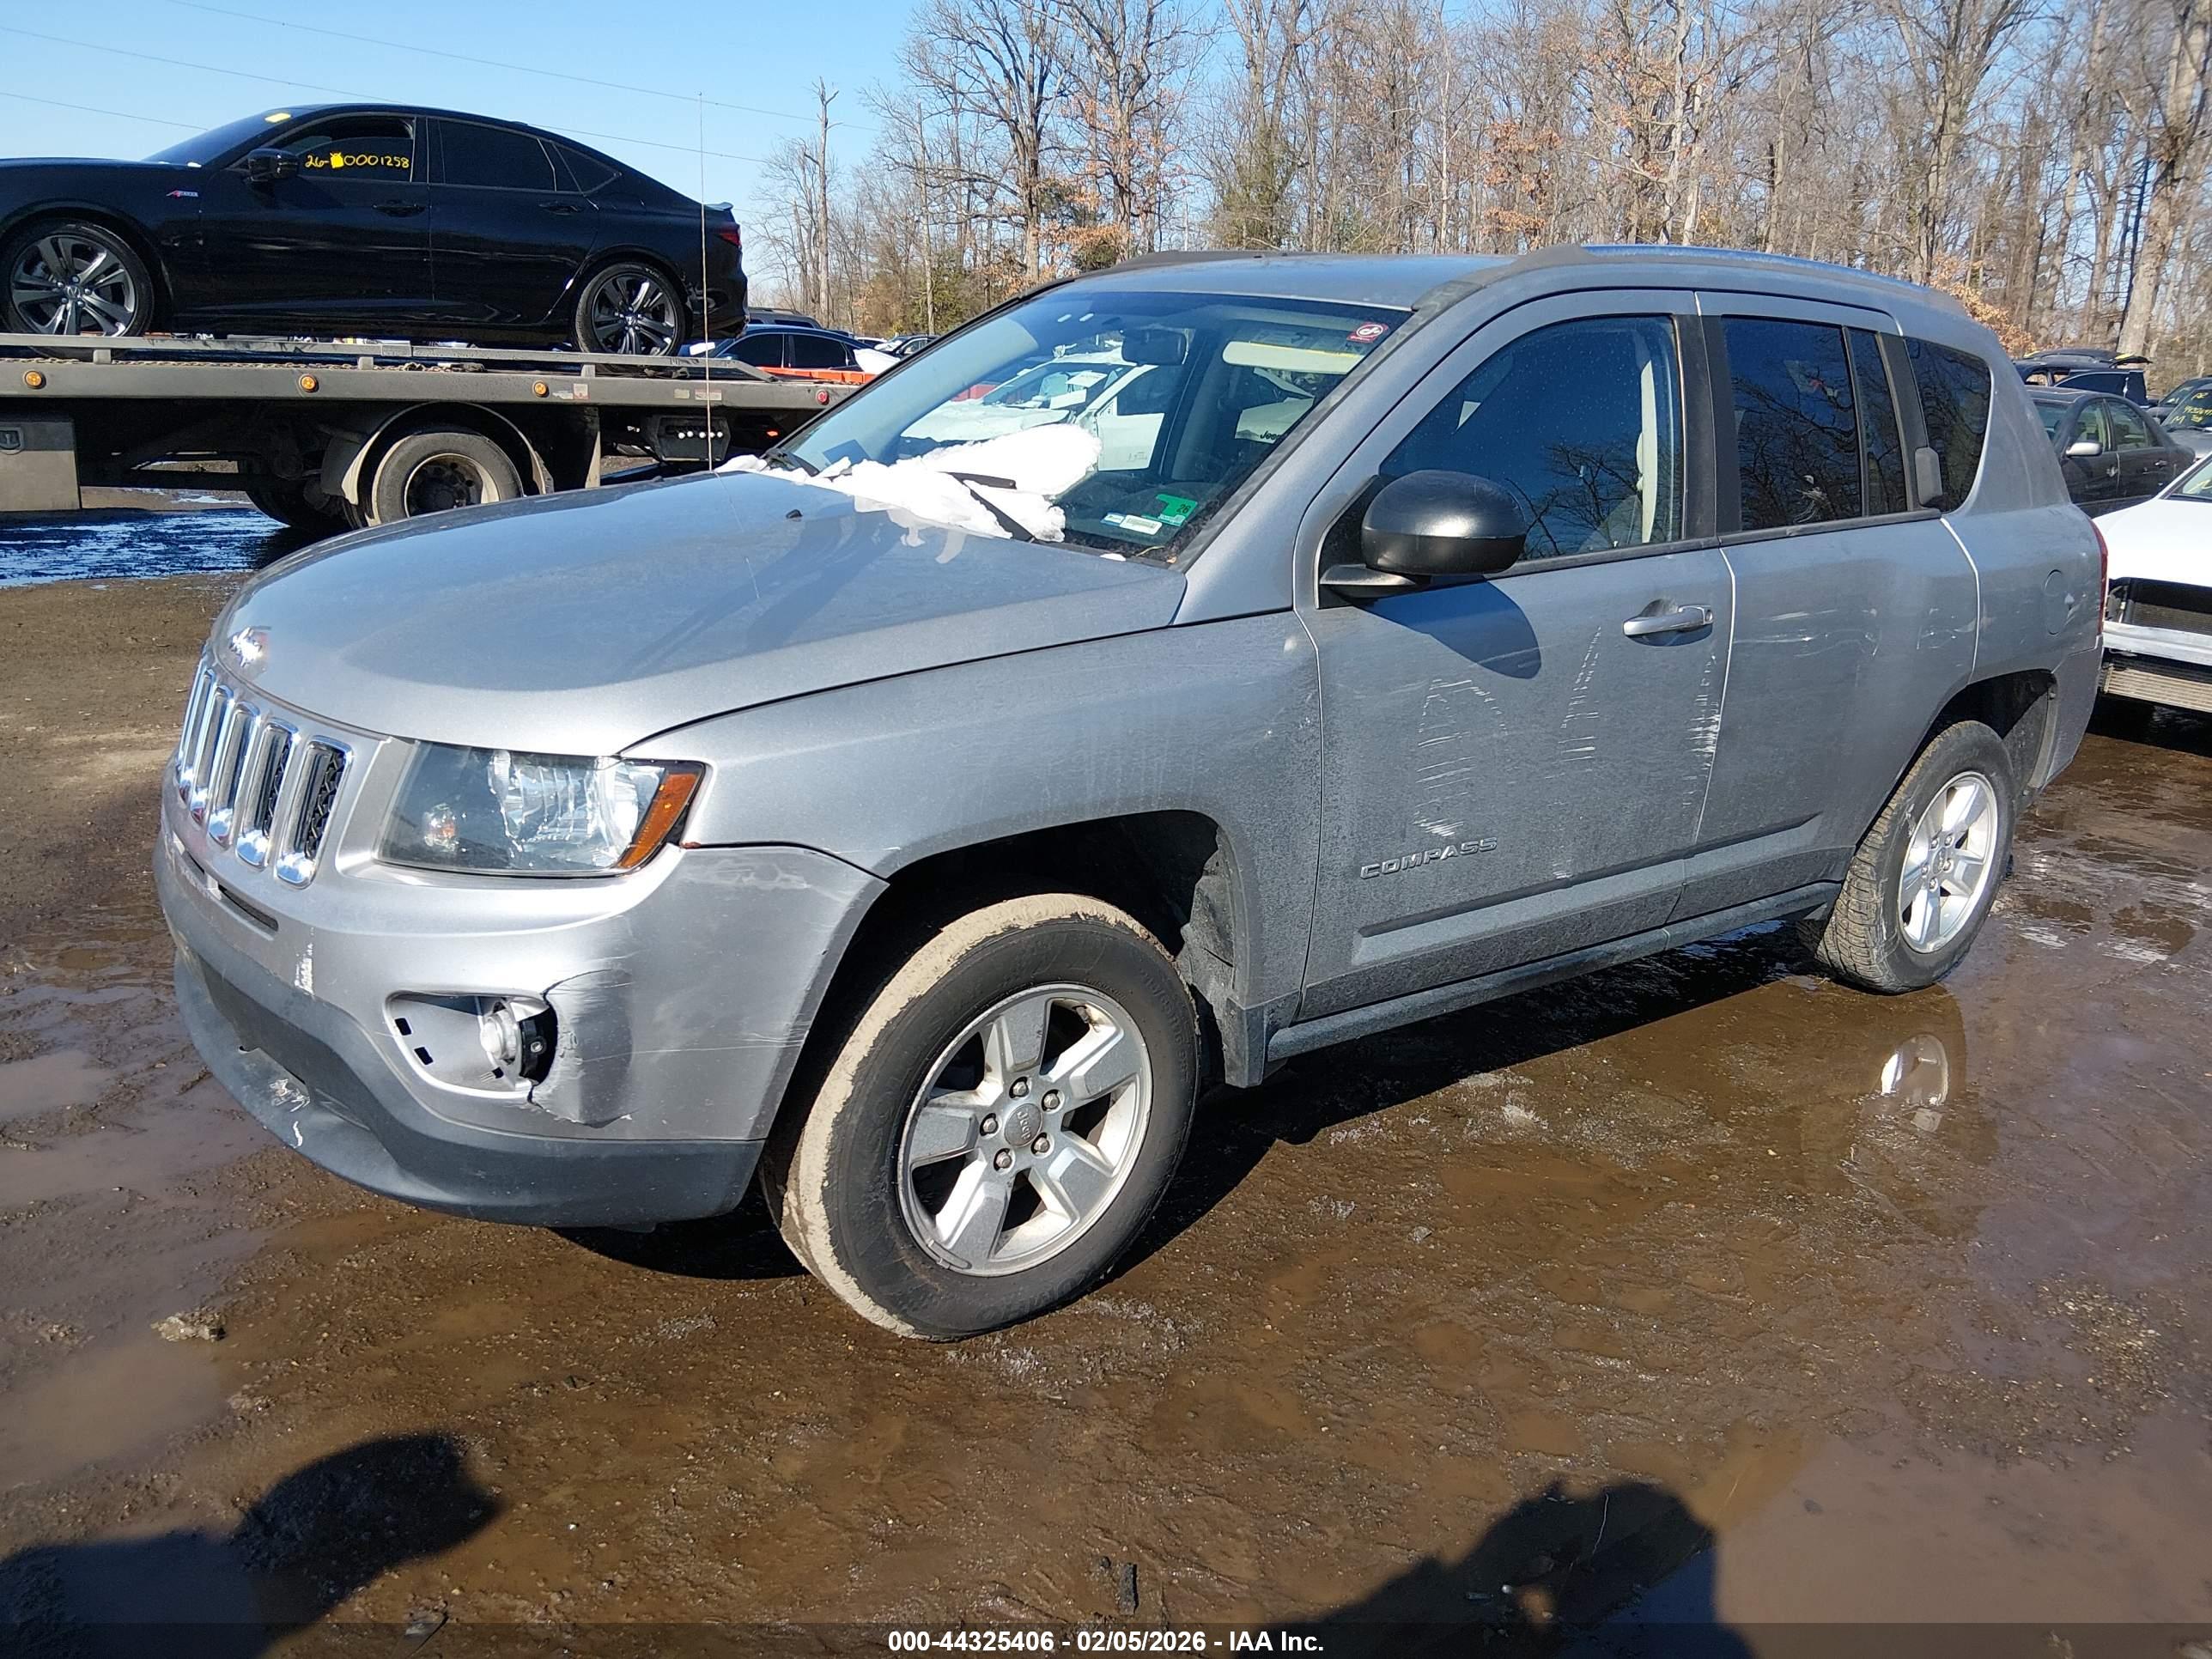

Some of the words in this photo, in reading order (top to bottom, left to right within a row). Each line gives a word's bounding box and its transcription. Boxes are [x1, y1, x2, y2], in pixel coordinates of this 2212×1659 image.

[1176, 503, 1191, 514] 26
[1360, 836, 1498, 879] COMPASS
[1017, 1110, 1032, 1140] Jeep
